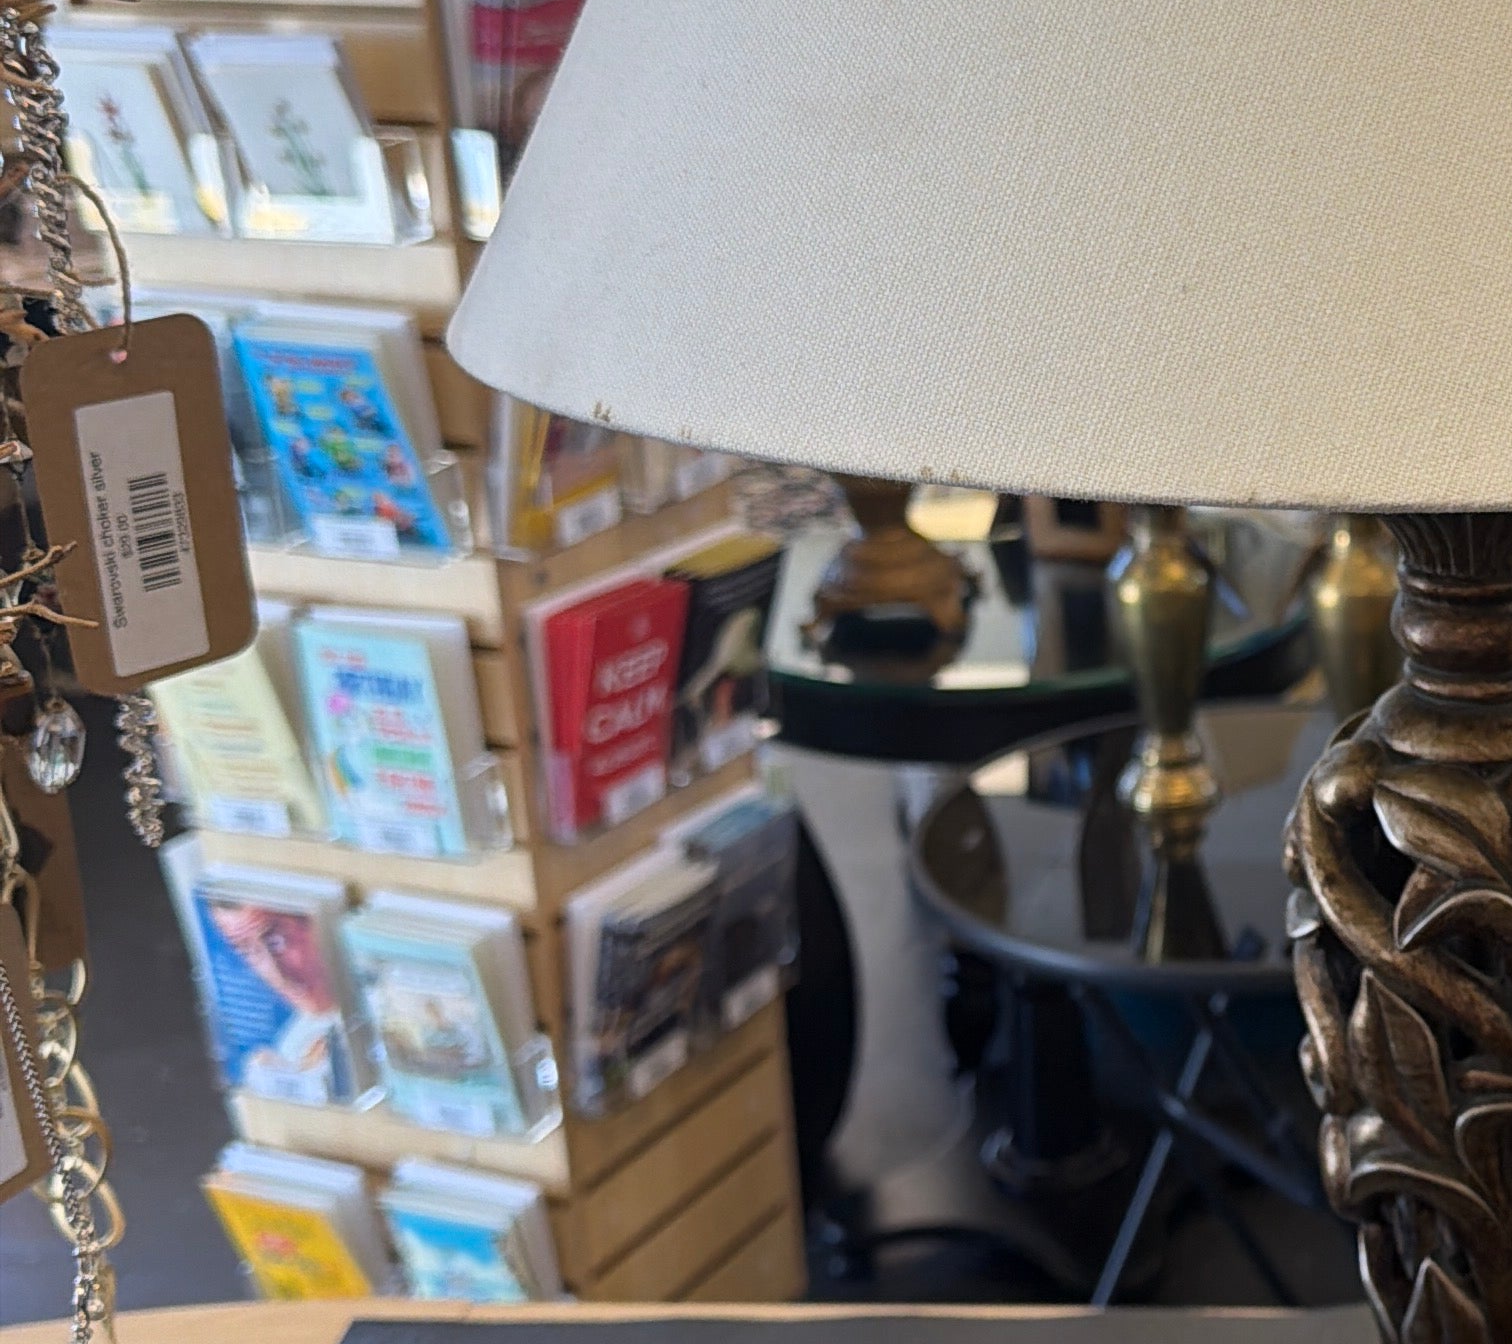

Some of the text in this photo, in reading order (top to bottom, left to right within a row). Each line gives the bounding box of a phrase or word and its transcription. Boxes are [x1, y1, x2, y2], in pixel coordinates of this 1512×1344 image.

[90, 451, 127, 630] Swarovski choker silver
[595, 638, 669, 697] KEEP
